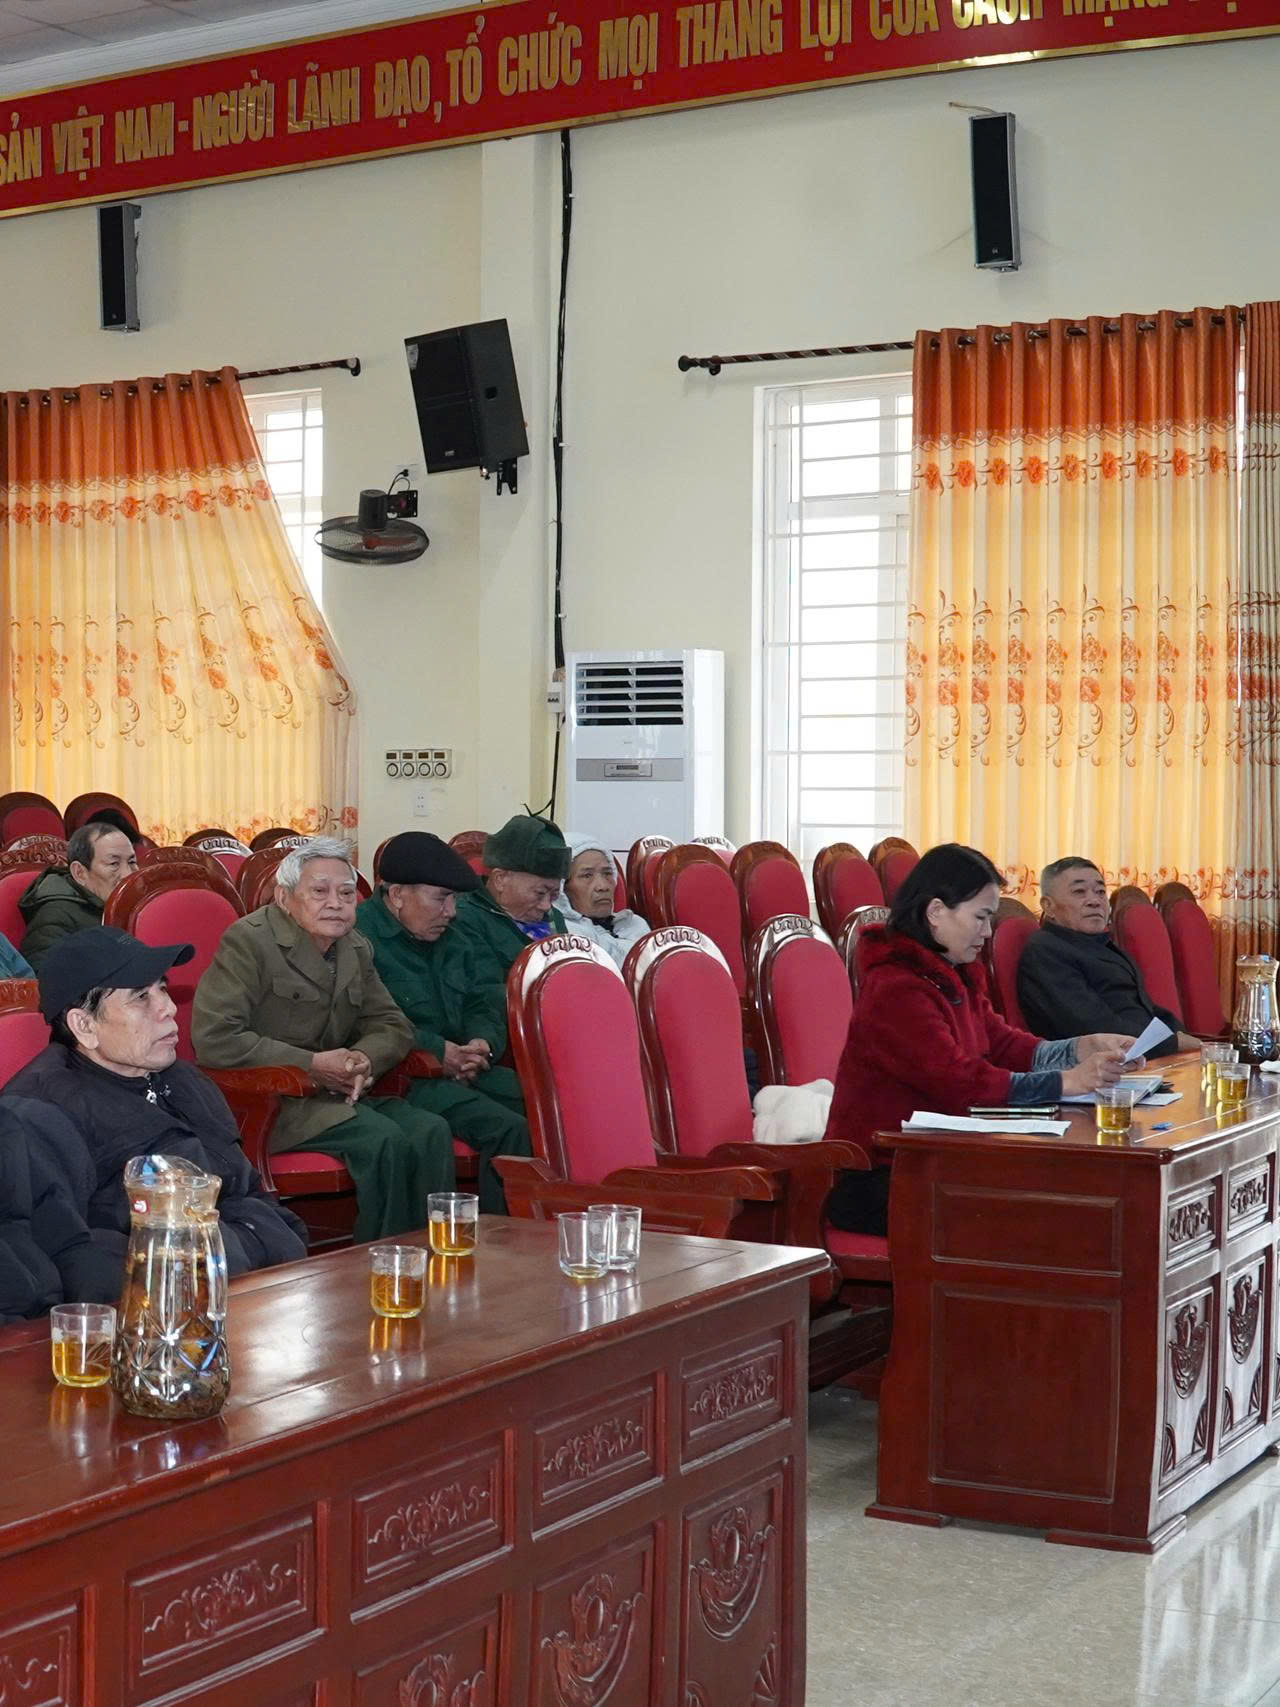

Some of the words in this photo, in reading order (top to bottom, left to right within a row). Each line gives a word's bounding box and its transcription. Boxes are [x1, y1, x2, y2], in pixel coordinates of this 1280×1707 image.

[51, 105, 104, 181] VIỆT
[288, 62, 361, 134] LÃNH
[446, 15, 485, 107] TỔ
[498, 11, 583, 96] CHỨC
[598, 12, 658, 90] MỌI
